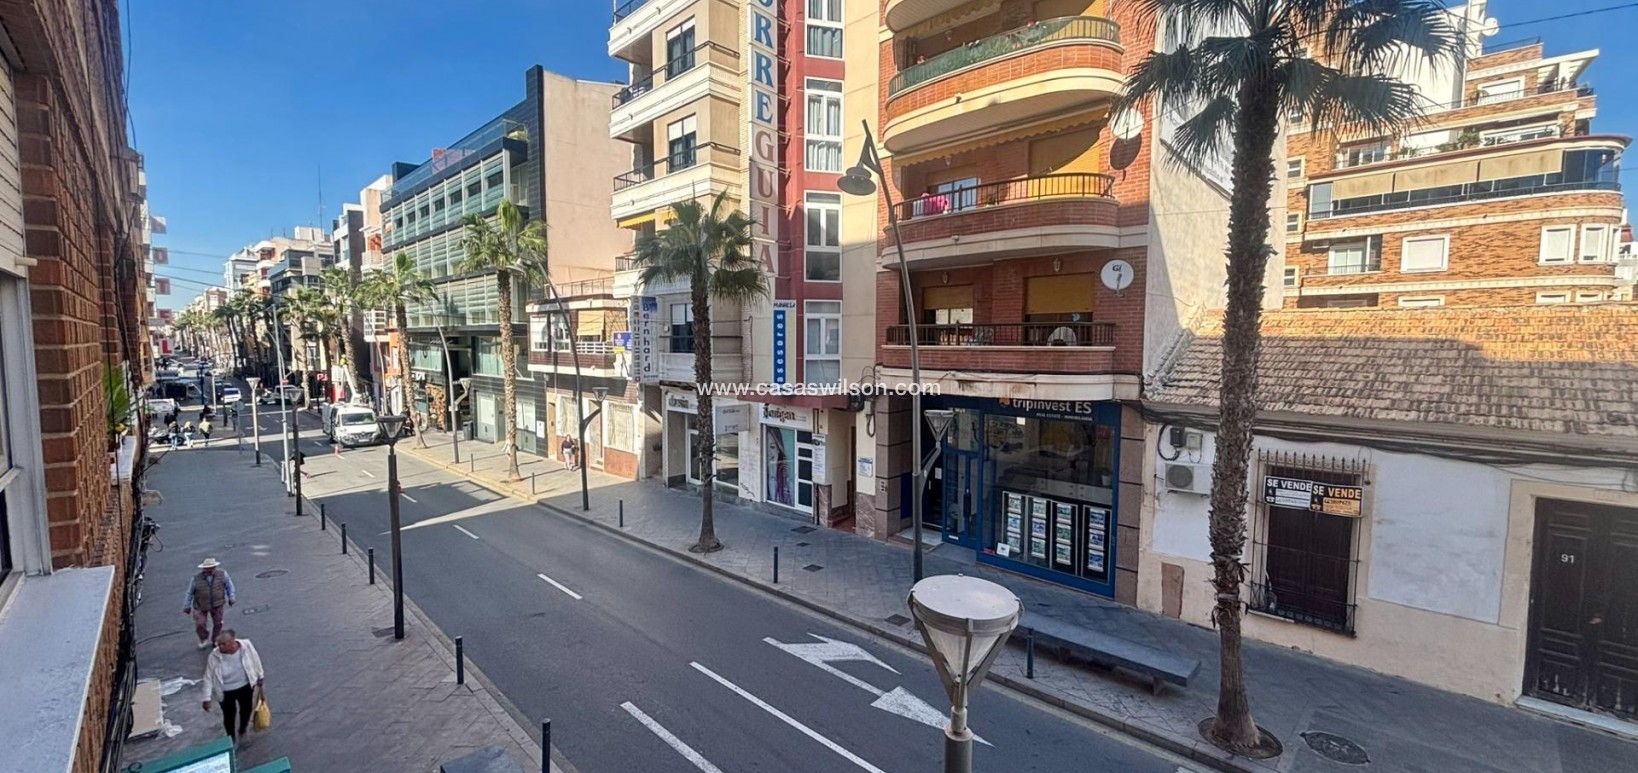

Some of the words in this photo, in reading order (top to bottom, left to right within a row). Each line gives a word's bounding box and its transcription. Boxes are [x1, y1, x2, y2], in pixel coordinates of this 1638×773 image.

[643, 303, 651, 372] Bernhard
[776, 313, 784, 383] asesores
[1012, 399, 1071, 412] tripinvest
[1075, 401, 1092, 414] ES
[1267, 479, 1278, 488] SE
[1280, 480, 1312, 491] VENDE
[1313, 485, 1324, 495] SE
[1328, 487, 1361, 499] VENDE
[1561, 553, 1575, 563] 91
